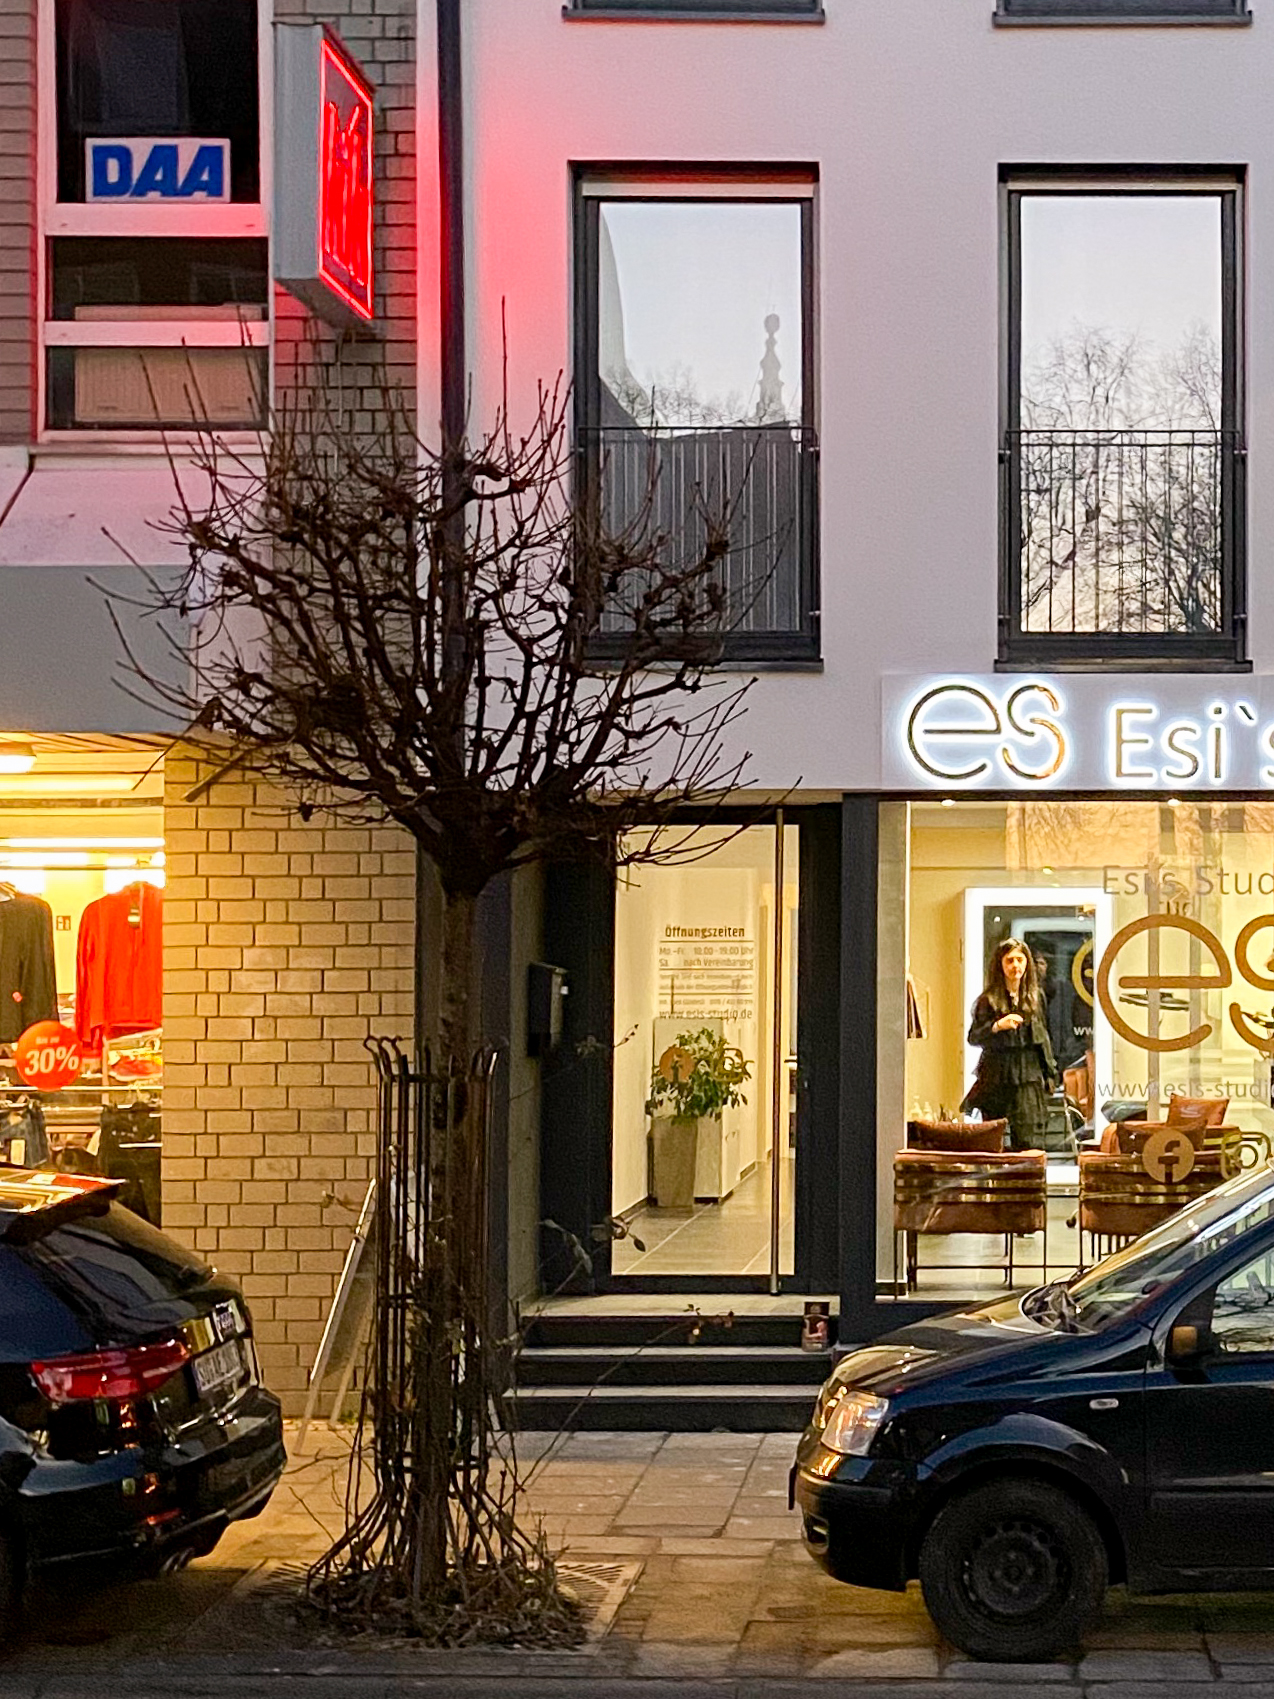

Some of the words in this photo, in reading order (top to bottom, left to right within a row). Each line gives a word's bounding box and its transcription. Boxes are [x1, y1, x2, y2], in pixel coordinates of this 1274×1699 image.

[92, 144, 224, 197] DAA
[907, 683, 1066, 781] es
[664, 923, 746, 940] Öffnungszeiten
[24, 1043, 80, 1076] 30%
